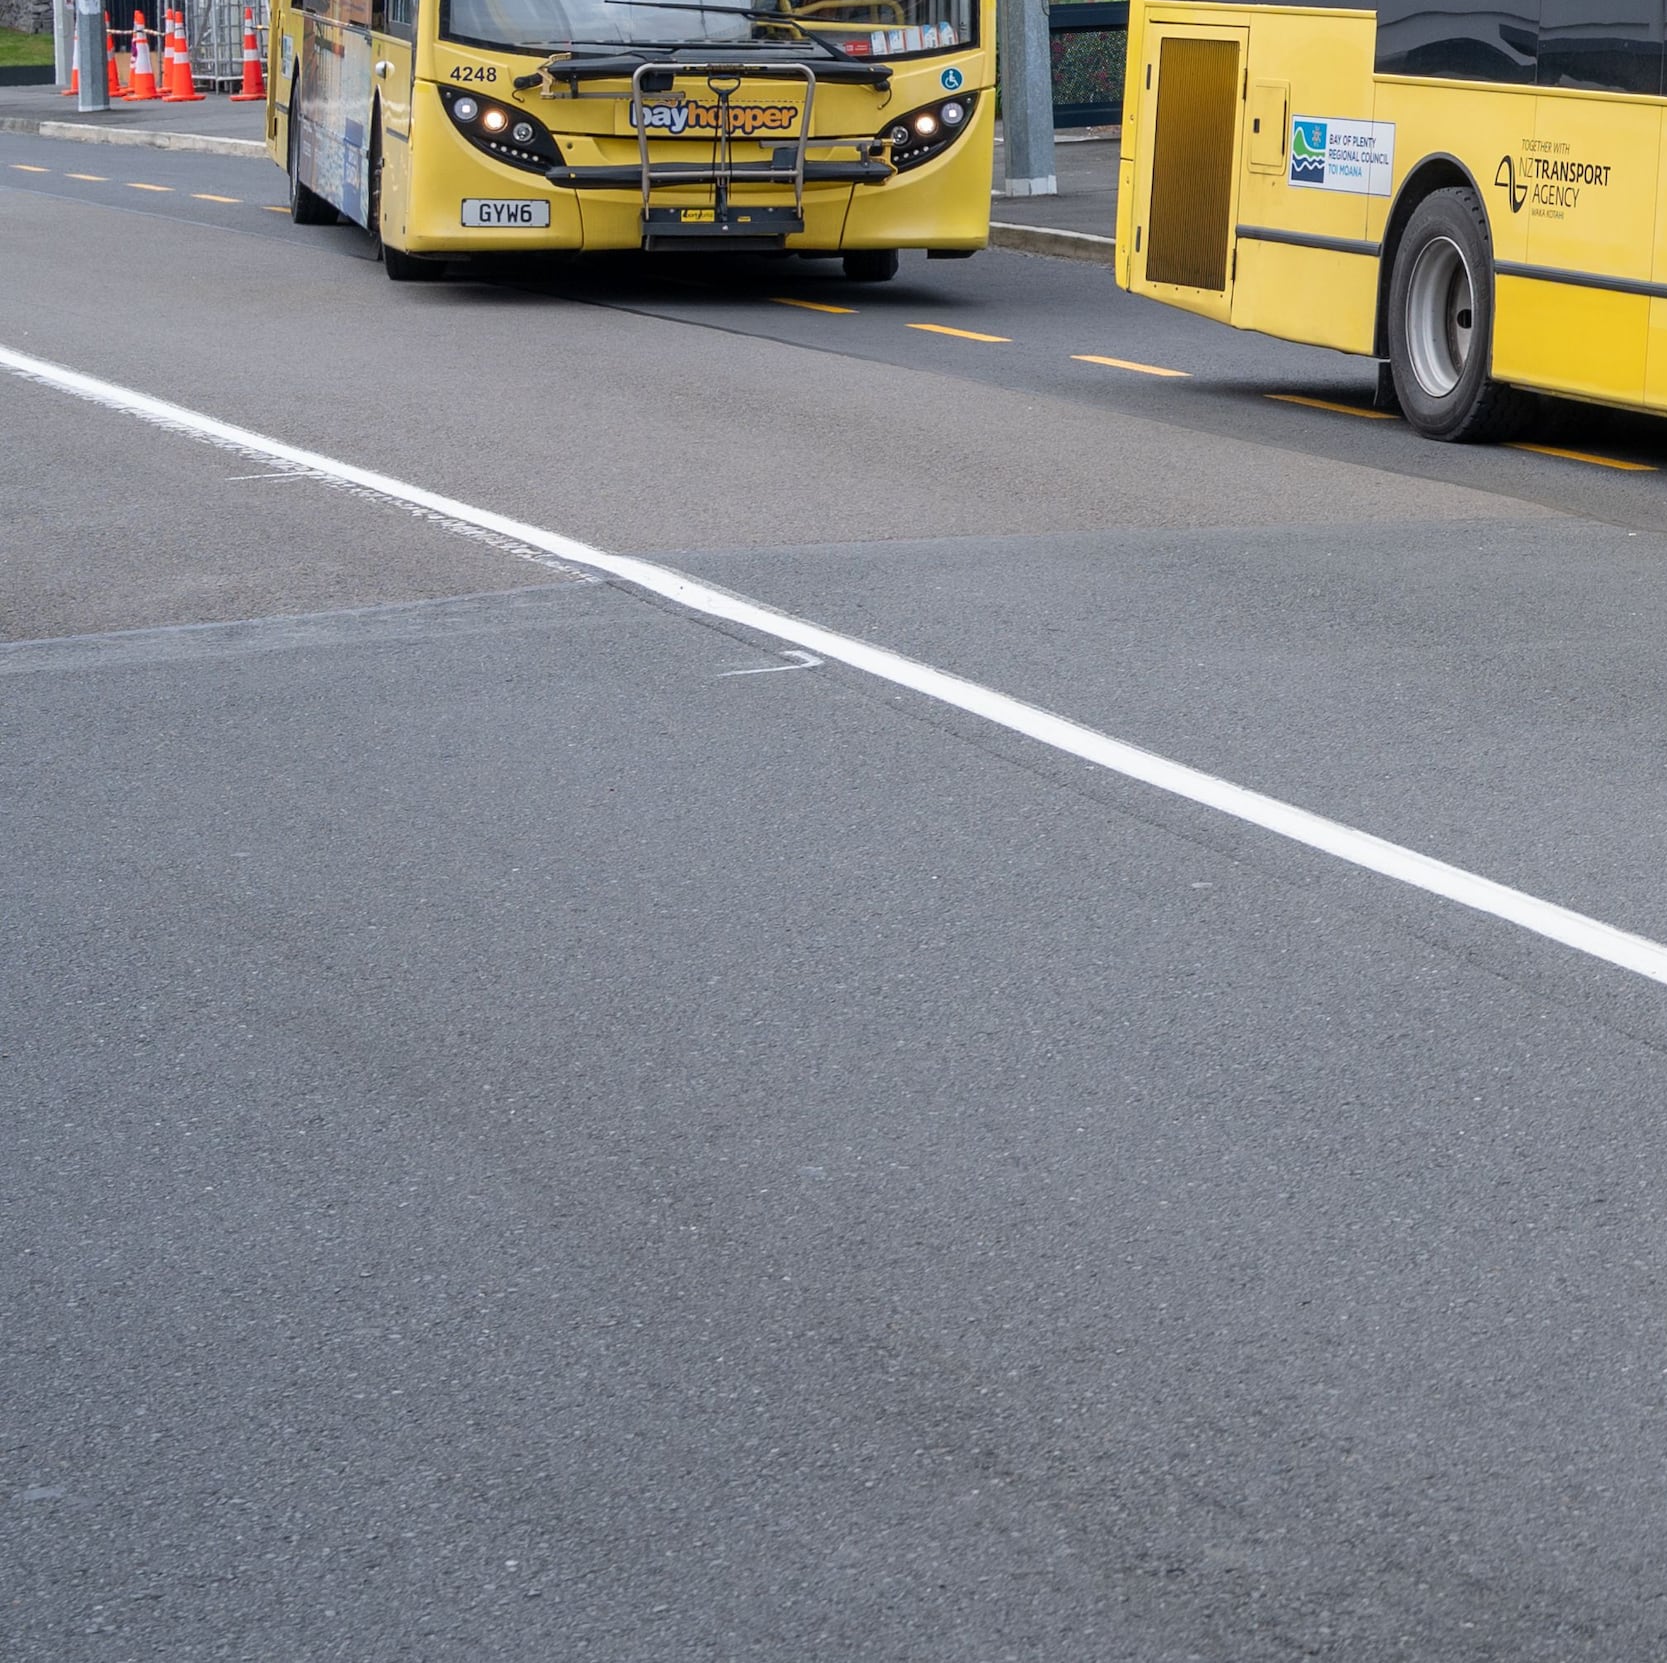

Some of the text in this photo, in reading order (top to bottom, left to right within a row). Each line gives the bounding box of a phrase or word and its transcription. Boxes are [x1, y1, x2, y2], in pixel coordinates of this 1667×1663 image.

[450, 65, 497, 83] 4248
[630, 100, 799, 133] bayhopper
[1329, 134, 1376, 148] BAY OF PLENTY
[1553, 142, 1570, 154] WITH
[1329, 149, 1389, 165] REGIONAL COUNCIL
[1532, 183, 1580, 208] AGENCY
[479, 203, 532, 224] GYW6
